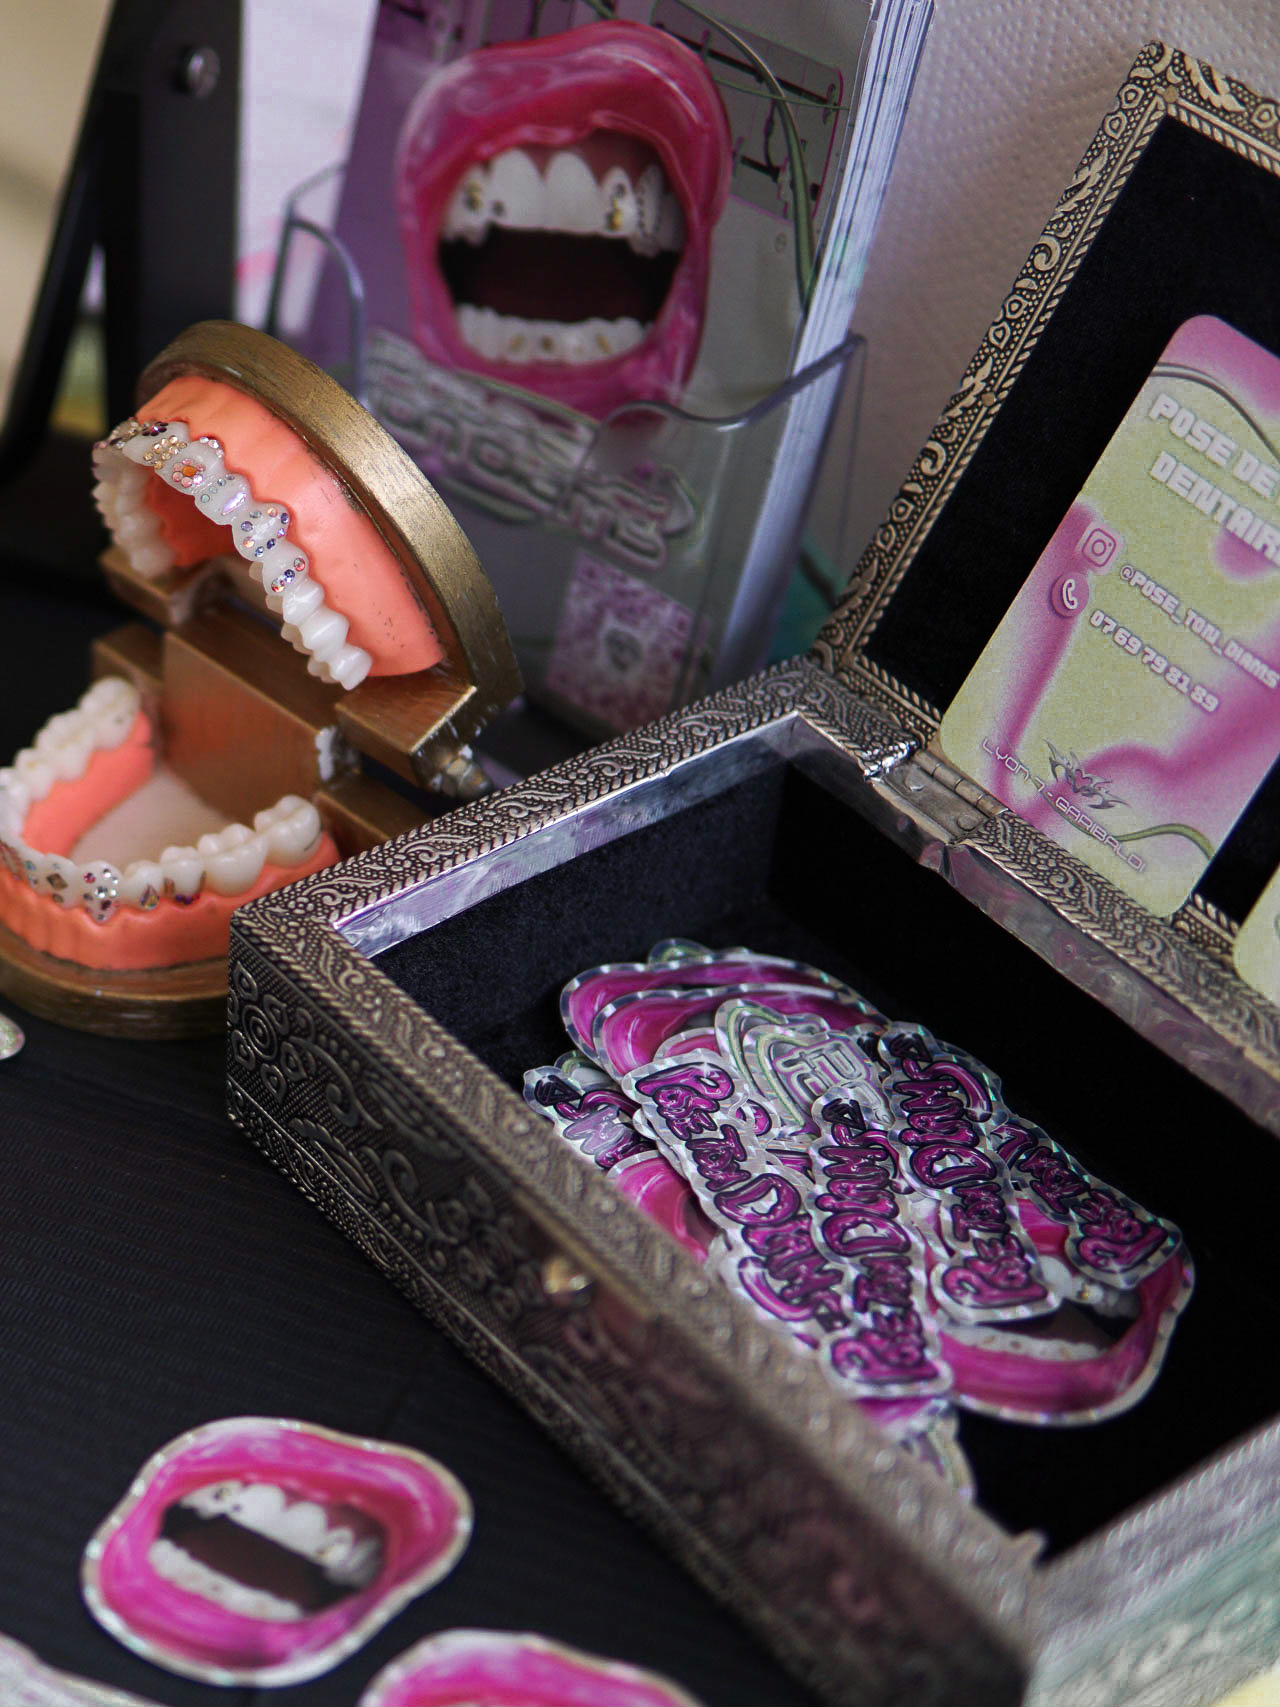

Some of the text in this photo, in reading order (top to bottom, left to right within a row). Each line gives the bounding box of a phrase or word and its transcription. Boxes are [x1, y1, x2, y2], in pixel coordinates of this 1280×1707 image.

[1148, 392, 1280, 499] POSE DE
[1149, 450, 1280, 569] DENTAIR
[1089, 609, 1219, 713] 07 69 79 81 89
[1055, 796, 1146, 873] GARIBALDI
